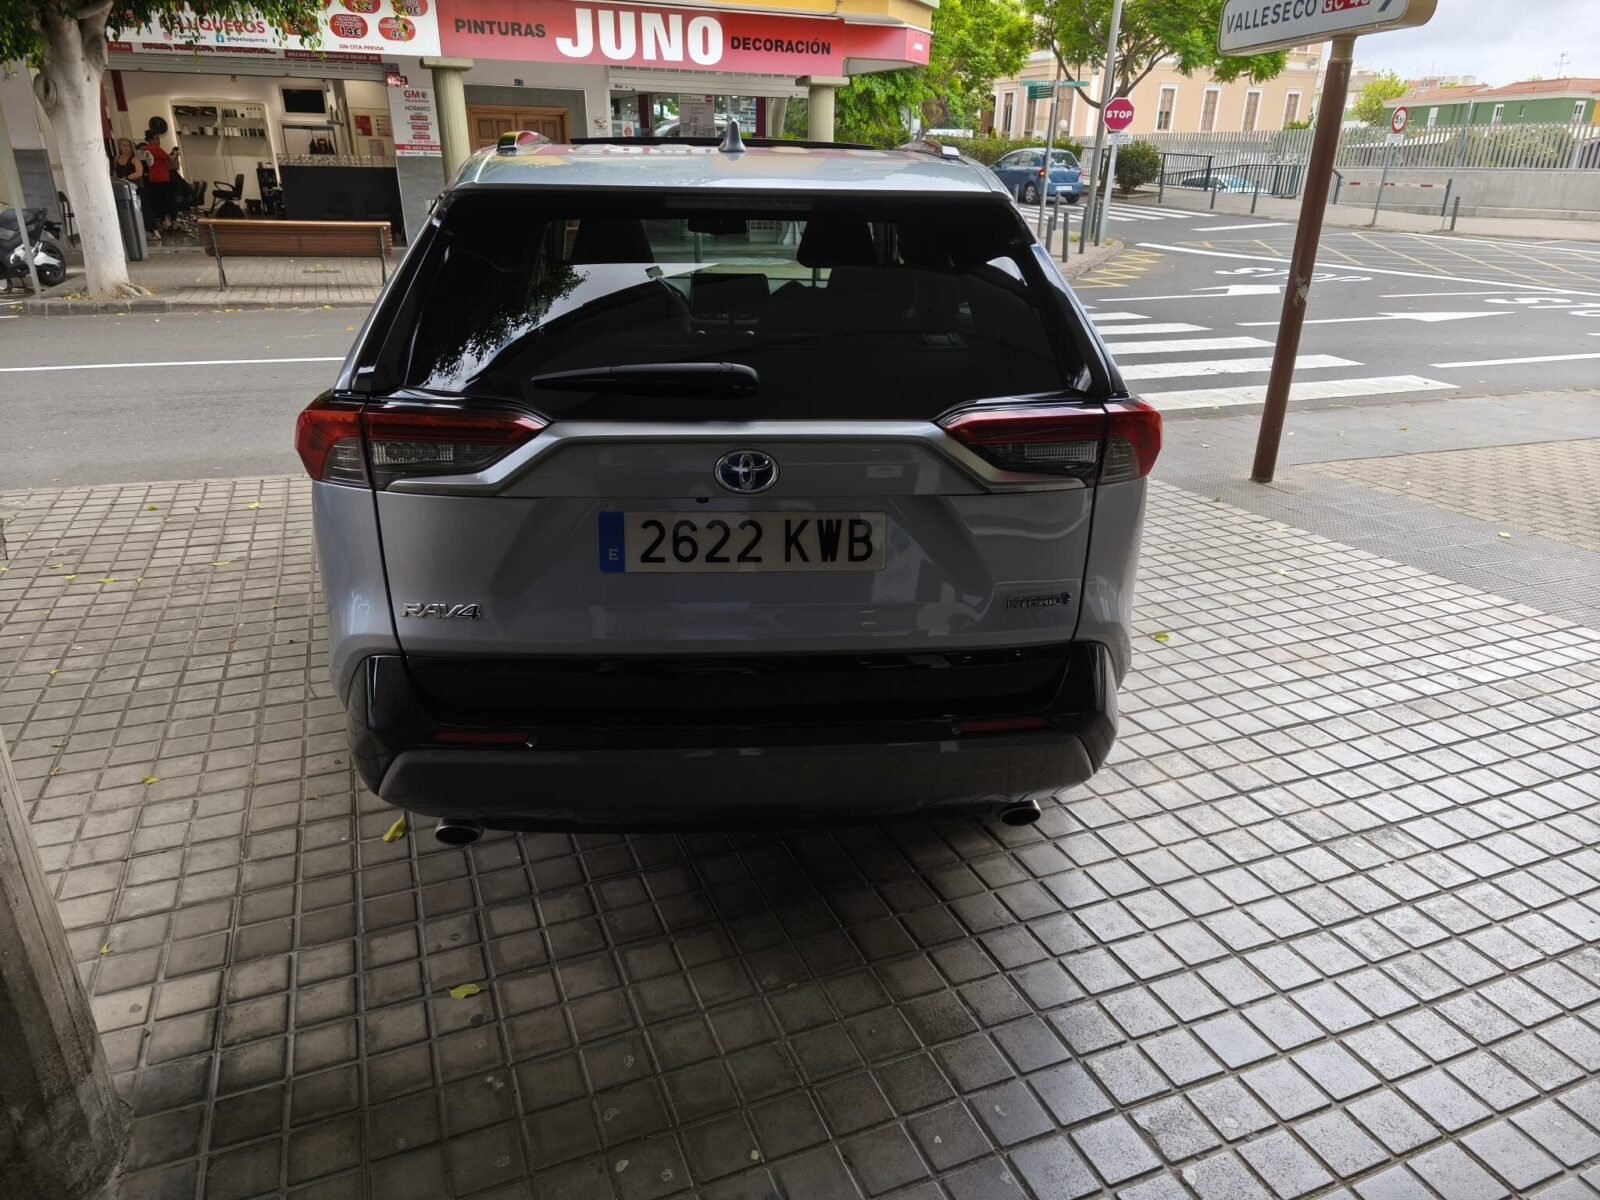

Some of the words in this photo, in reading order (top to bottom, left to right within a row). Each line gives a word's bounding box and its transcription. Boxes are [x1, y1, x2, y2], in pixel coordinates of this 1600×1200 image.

[159, 15, 265, 34] LUQUEROS
[1226, 0, 1317, 34] VALLESECO
[1323, 0, 1345, 11] GC
[340, 27, 361, 36] 14€
[454, 18, 546, 38] PINTURAS
[555, 8, 724, 66] JUNO
[730, 36, 831, 55] DECORACIÓN
[403, 90, 420, 99] GM
[1106, 110, 1133, 119] STOP
[608, 548, 619, 561] E
[640, 519, 763, 563] 2622
[784, 519, 874, 563] KWB
[400, 603, 481, 620] RAV4
